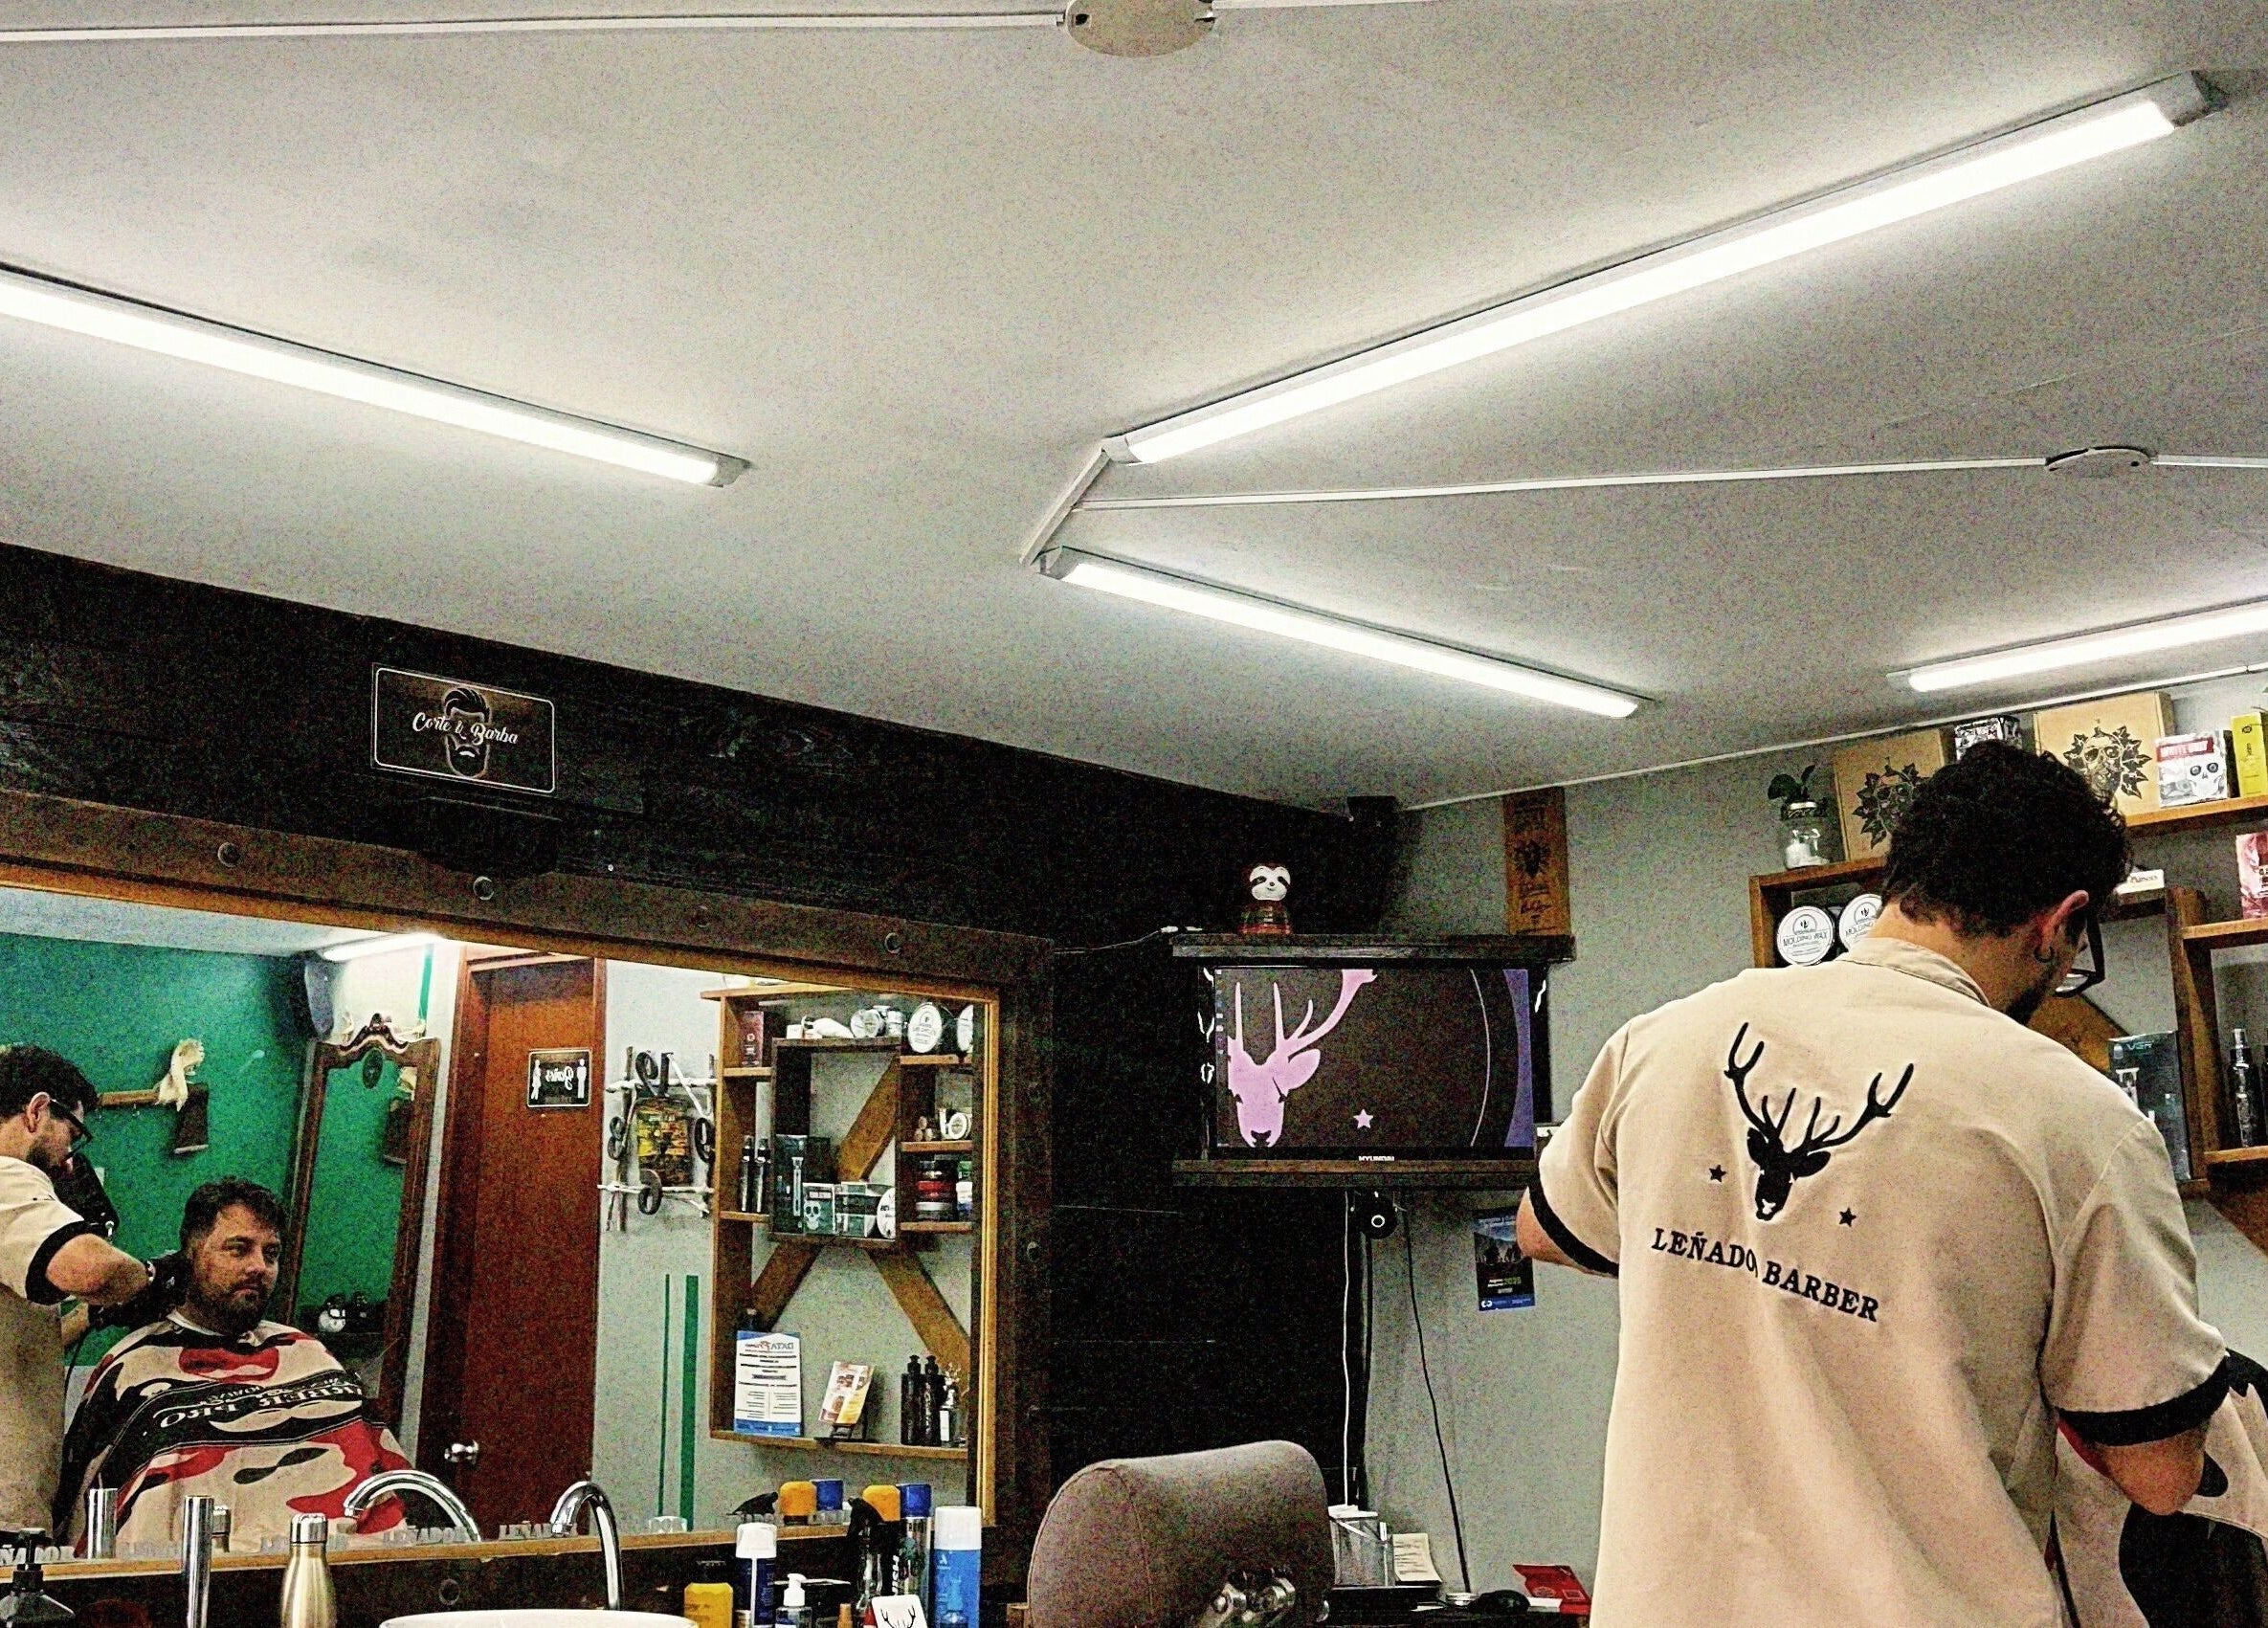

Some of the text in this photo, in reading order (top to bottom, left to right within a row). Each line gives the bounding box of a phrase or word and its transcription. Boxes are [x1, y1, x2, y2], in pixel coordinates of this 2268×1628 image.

[411, 711, 452, 732] Corte
[470, 723, 519, 746] Barba
[1651, 1227, 1879, 1323] LEÑADO BARBER
